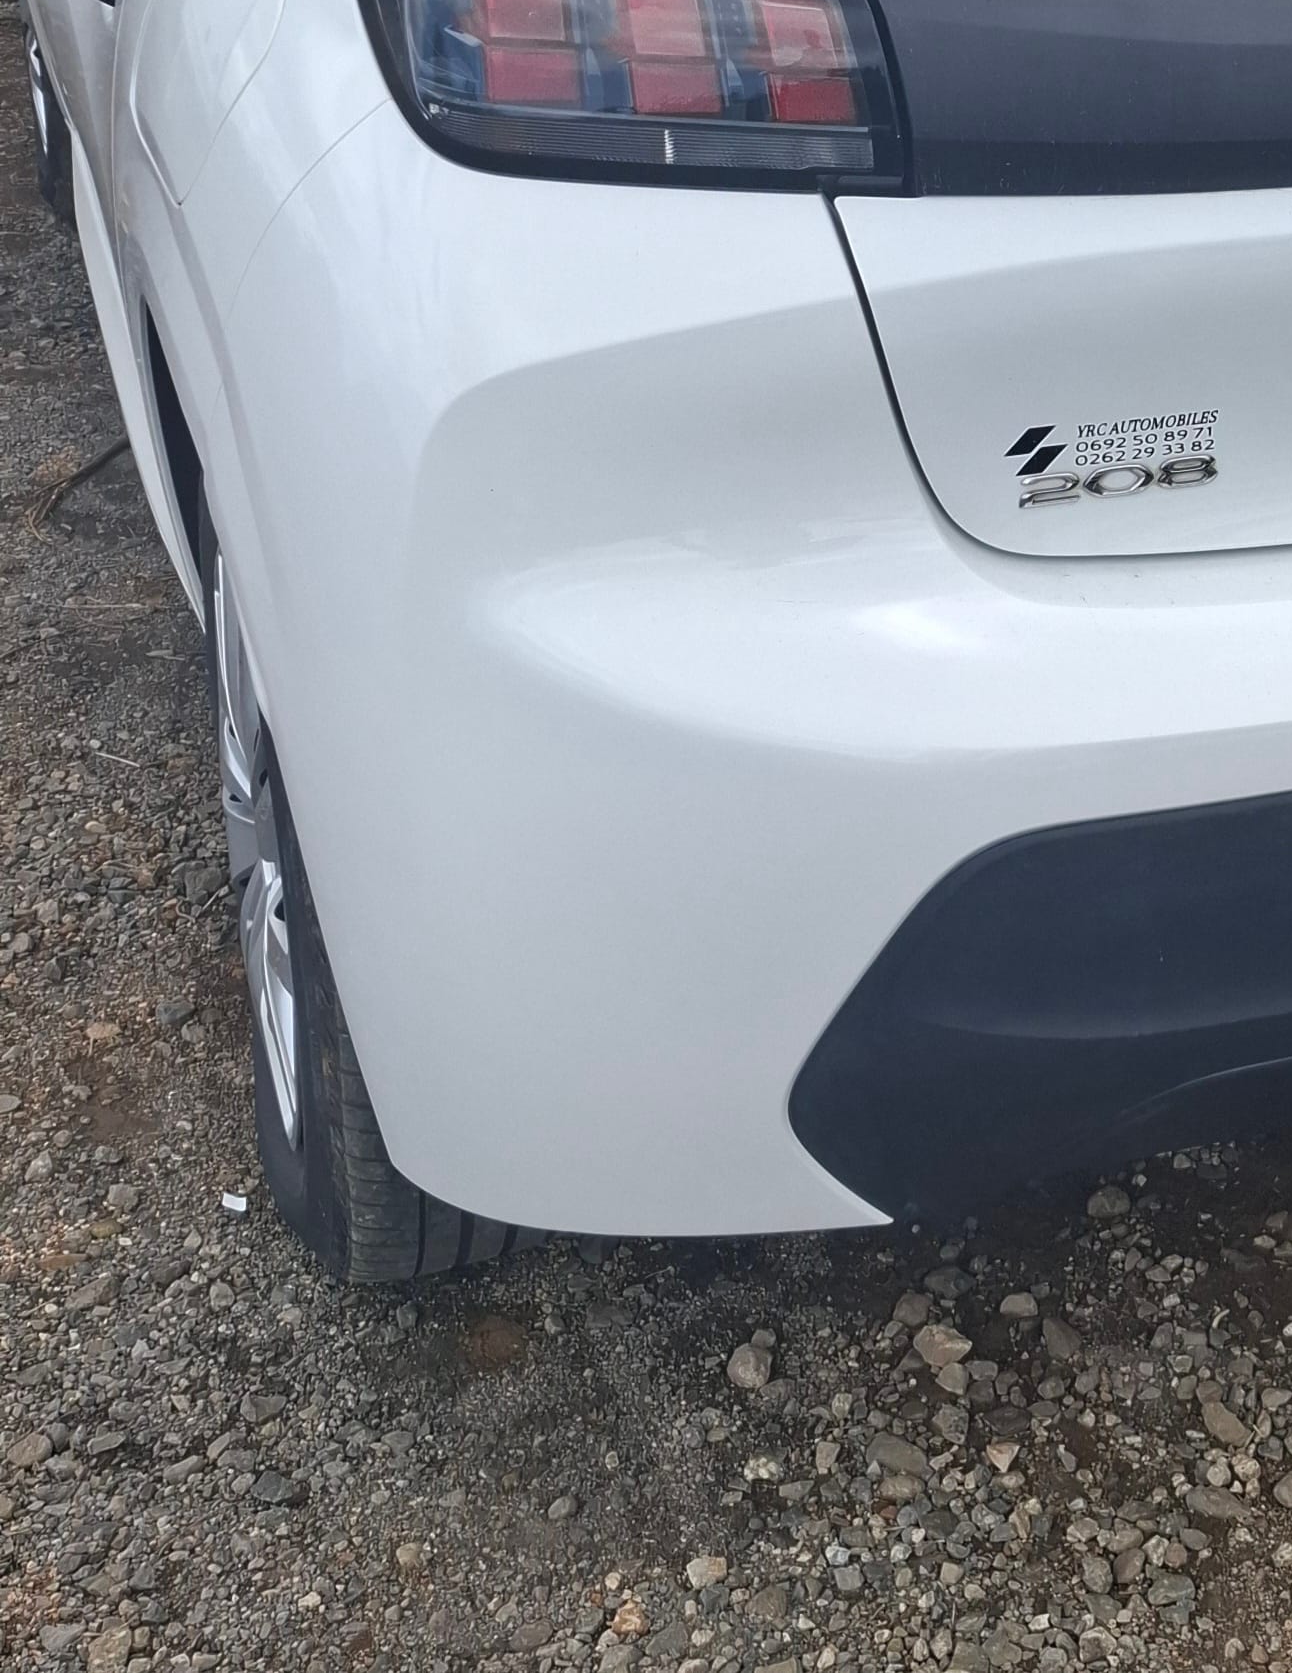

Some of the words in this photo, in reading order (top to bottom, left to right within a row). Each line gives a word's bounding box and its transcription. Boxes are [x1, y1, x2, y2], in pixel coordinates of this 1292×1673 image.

[1077, 422, 1108, 439] YRC
[1109, 410, 1219, 436] AUTOMOBILES
[1075, 437, 1127, 453] 0692
[1132, 433, 1158, 446] 50
[1163, 429, 1188, 442] 89
[1191, 426, 1214, 438] 71
[1075, 450, 1127, 466] 0262
[1132, 447, 1156, 459] 29
[1162, 443, 1186, 456] 33
[1191, 439, 1215, 452] 82
[1018, 454, 1219, 509] 208
